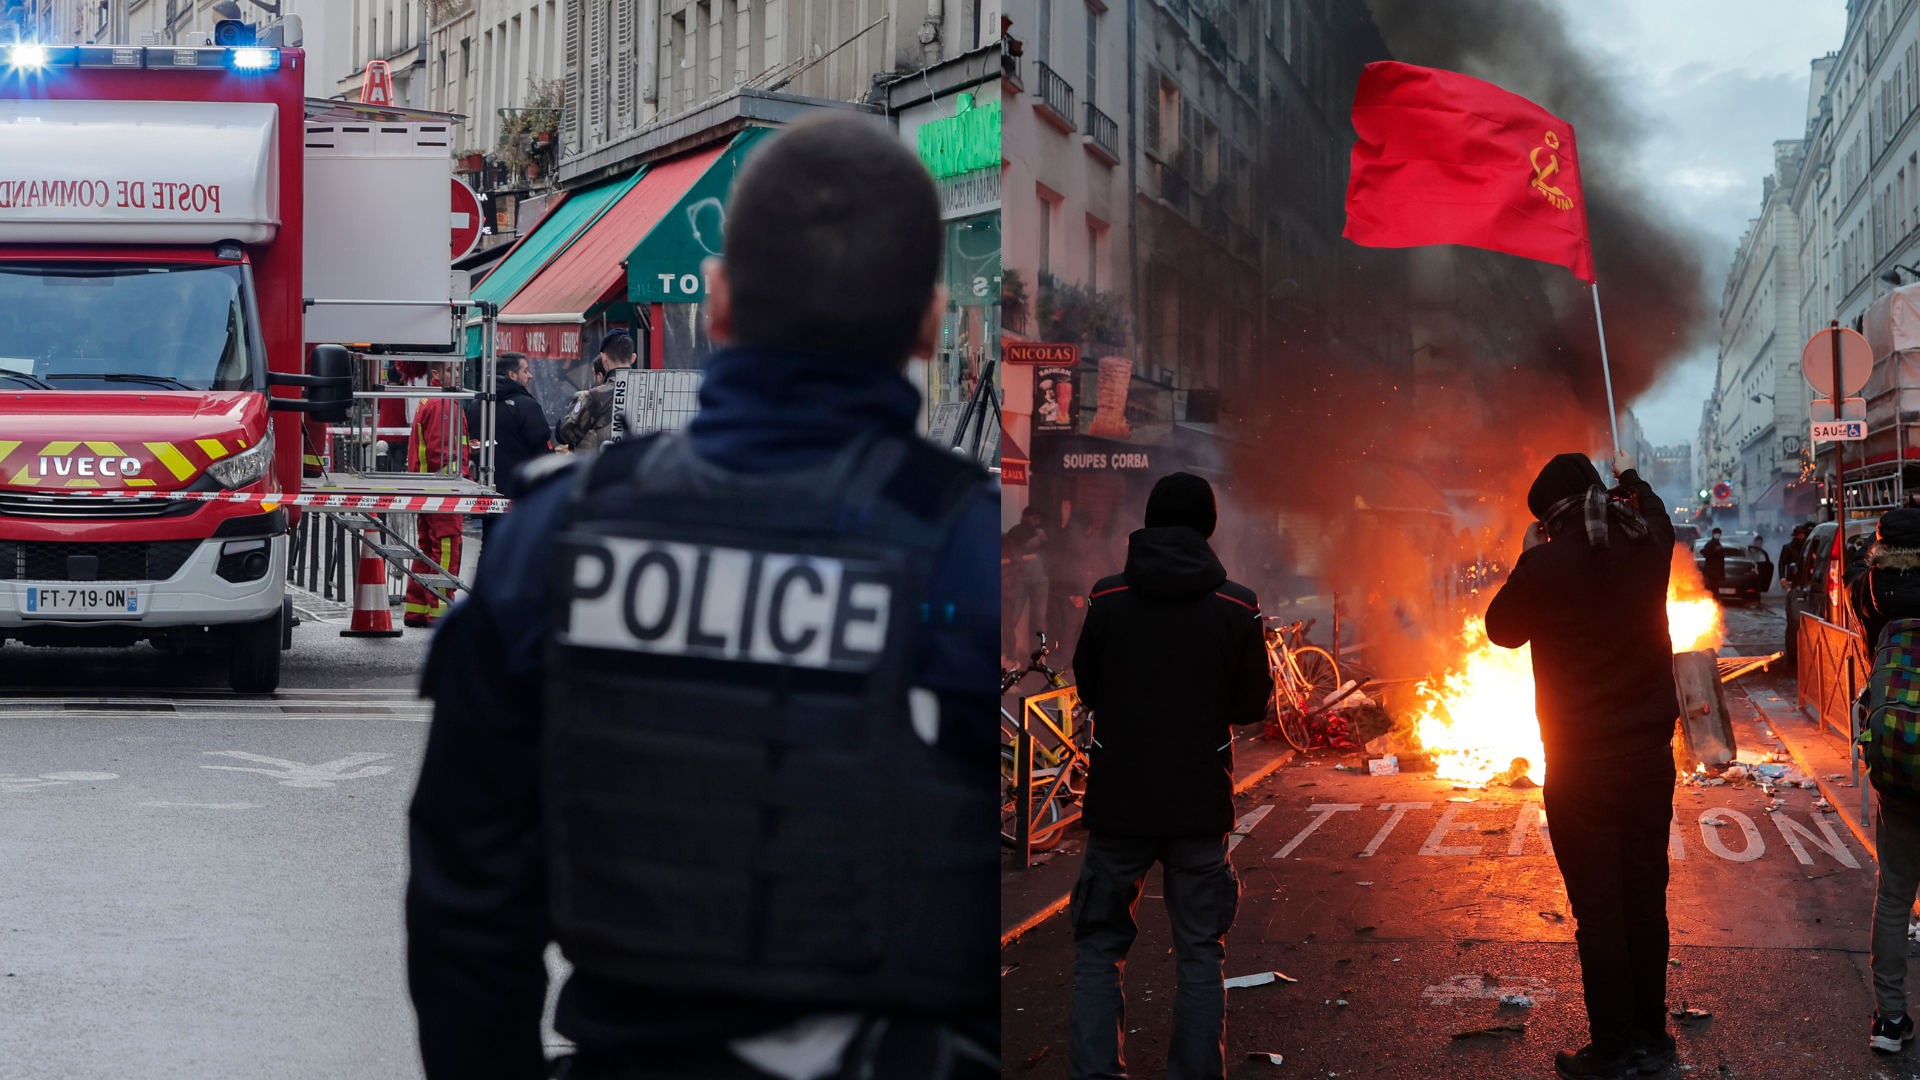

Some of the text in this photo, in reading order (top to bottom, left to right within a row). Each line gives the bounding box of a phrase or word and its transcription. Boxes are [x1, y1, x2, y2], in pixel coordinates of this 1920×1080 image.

[1010, 347, 1071, 360] NICOLAS
[613, 380, 626, 432] MOYENS
[1813, 426, 1846, 436] SAU
[39, 457, 142, 476] IVECO
[1063, 453, 1149, 470] SOUPES ÇORBA
[1001, 469, 1024, 480] EAUX
[40, 590, 125, 607] FT-719-QN
[128, 599, 137, 608] 75
[563, 546, 890, 661] POLICE
[1228, 801, 1861, 869] TTENION
